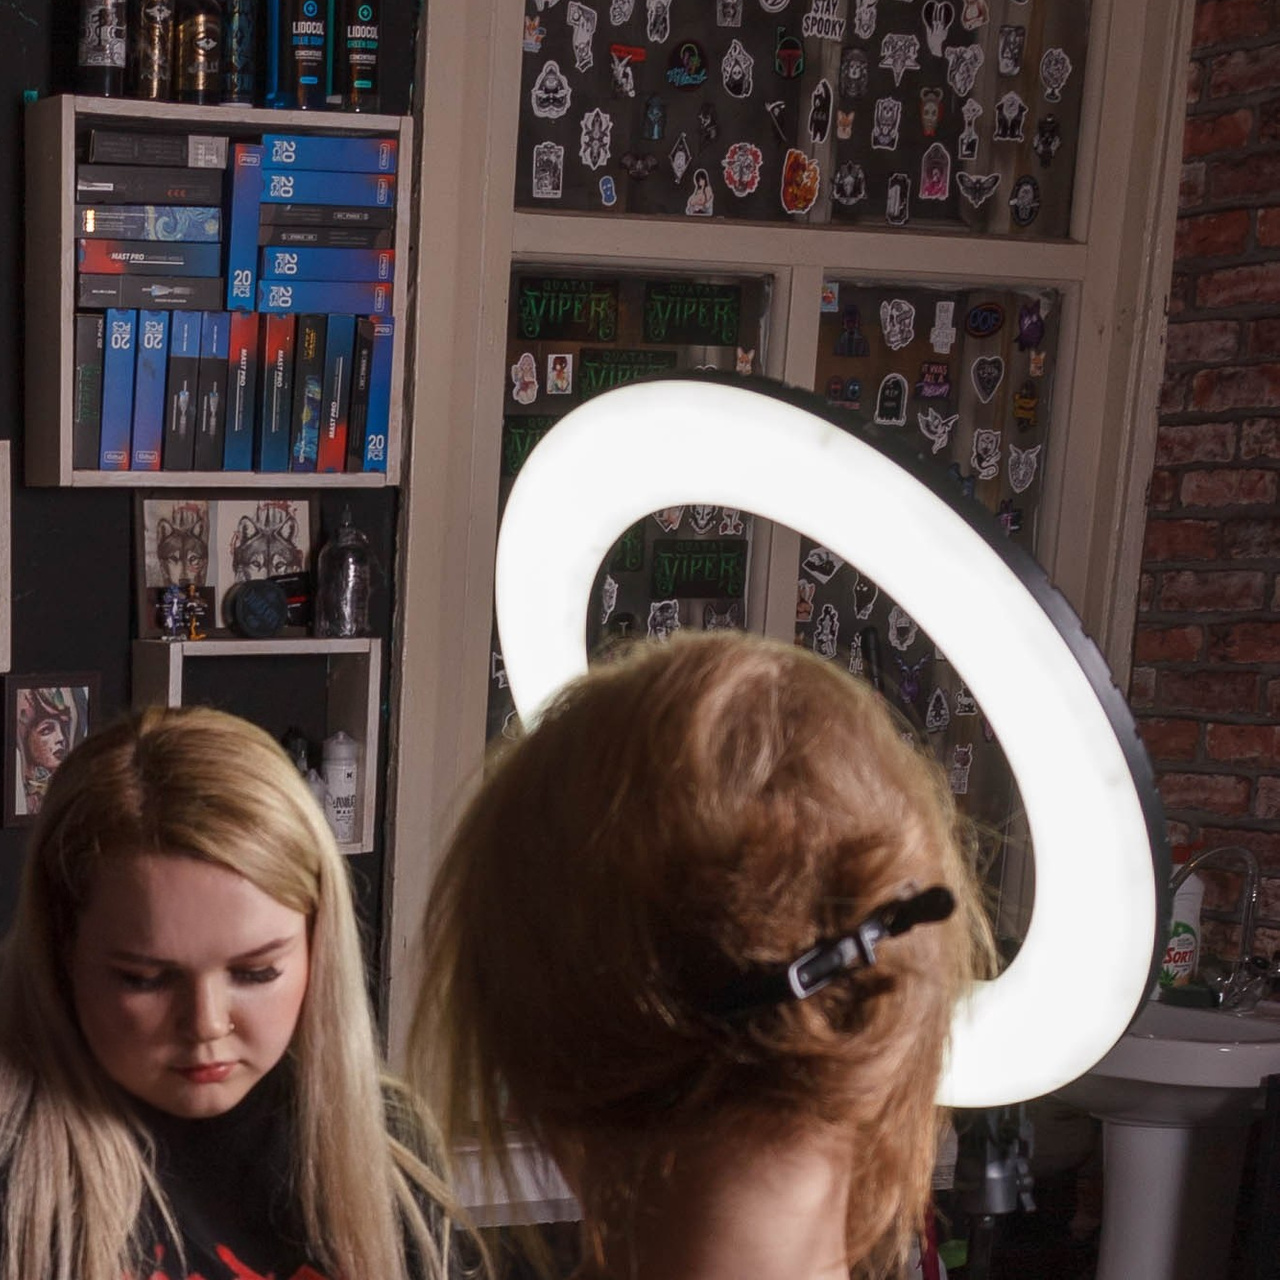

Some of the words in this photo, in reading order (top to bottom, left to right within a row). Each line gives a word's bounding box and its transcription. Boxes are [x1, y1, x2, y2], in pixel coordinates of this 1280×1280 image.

[813, 0, 838, 15] STAY
[803, 16, 844, 37] SPOOKY
[272, 141, 282, 163] PCS
[282, 141, 296, 163] 20
[270, 176, 280, 197] PCS
[280, 176, 294, 197] 20
[111, 252, 130, 261] MAST
[130, 253, 145, 261] PRO
[275, 253, 284, 274] PCS
[284, 253, 298, 274] 20
[234, 270, 252, 285] 20
[233, 286, 250, 298] PCS
[269, 286, 279, 307] PCS
[279, 286, 293, 307] 20
[524, 289, 615, 336] VIPER
[651, 294, 734, 338] VIPER
[112, 321, 131, 331] PCS
[144, 321, 163, 331] PCS
[111, 334, 130, 349] 20
[144, 334, 162, 349] 20
[368, 435, 384, 449] 20
[367, 449, 384, 461] PCS
[658, 552, 740, 593] VIPER
